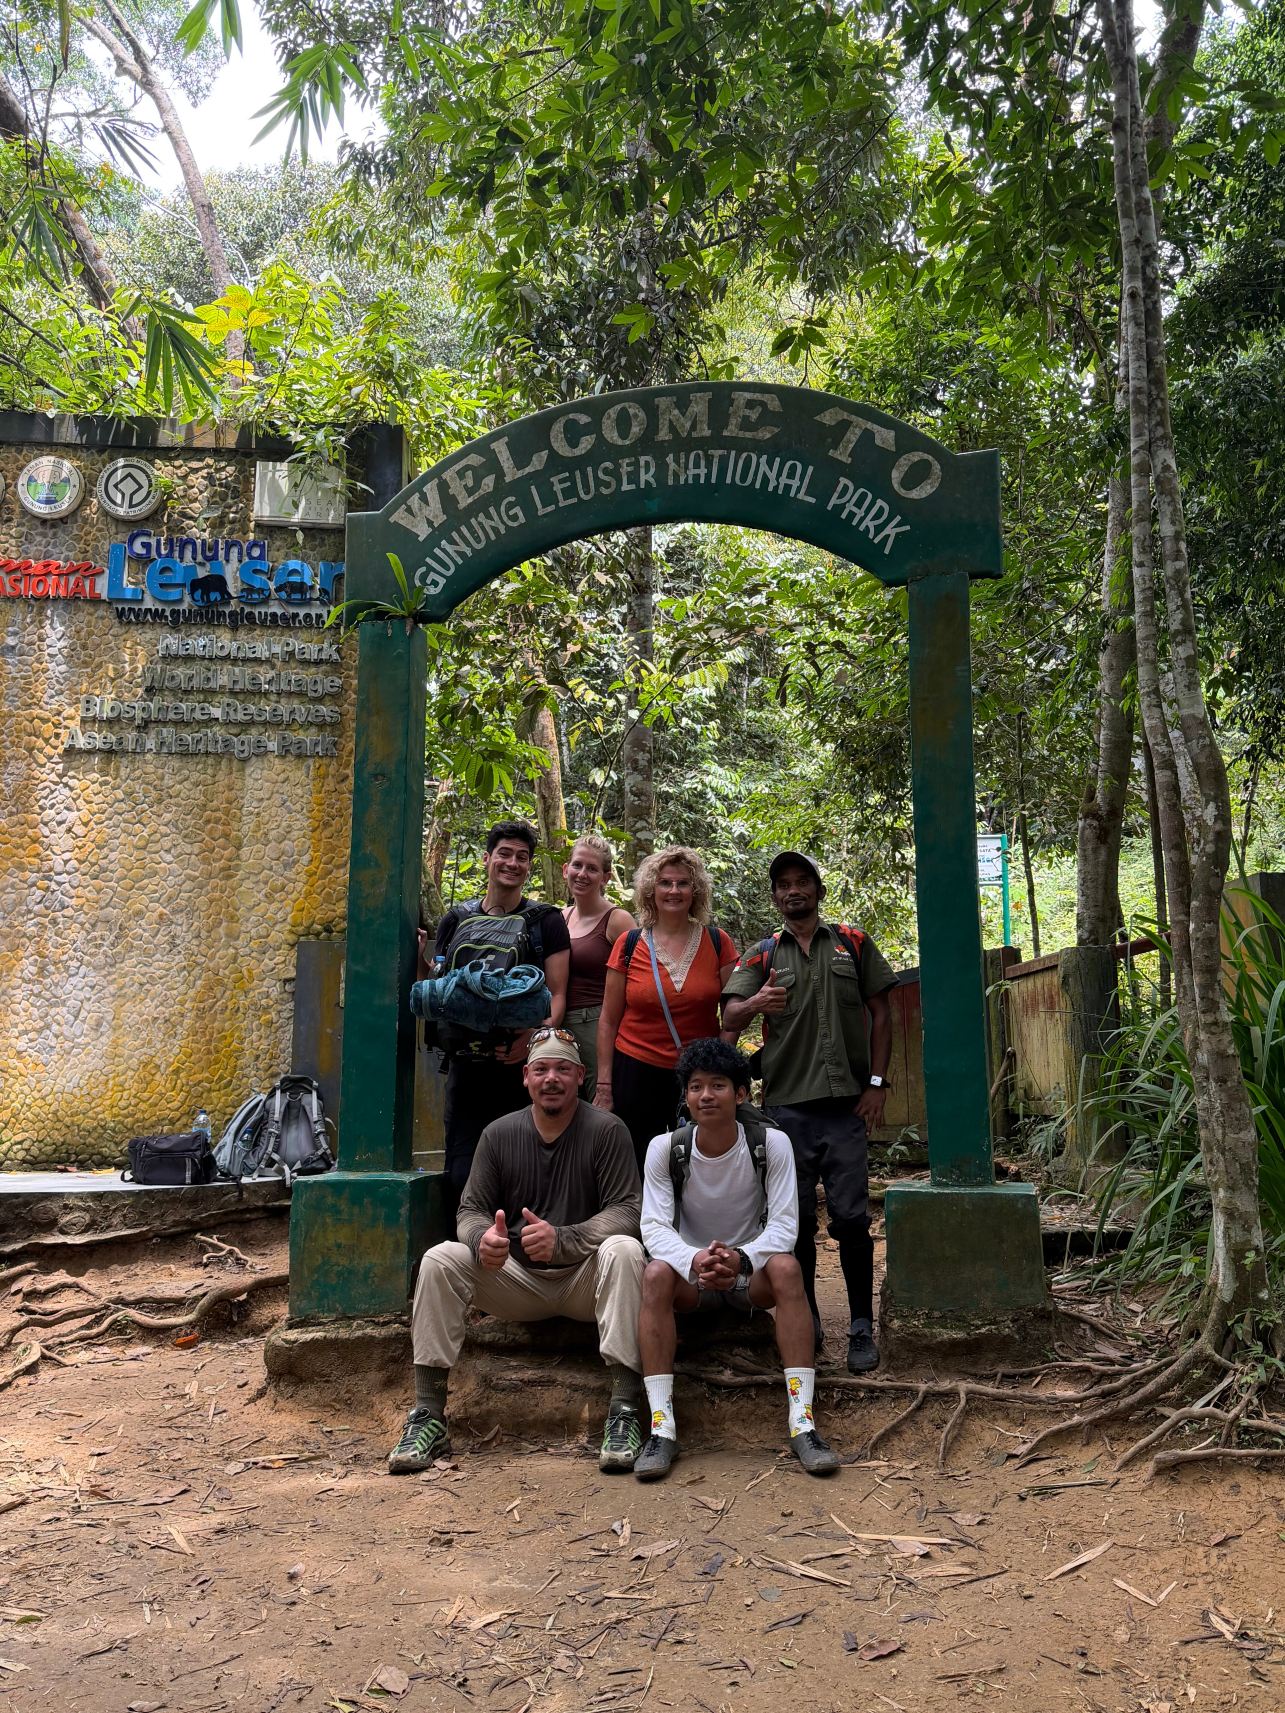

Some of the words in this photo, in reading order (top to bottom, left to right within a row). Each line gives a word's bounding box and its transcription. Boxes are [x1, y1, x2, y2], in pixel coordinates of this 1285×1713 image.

[389, 391, 784, 542] WELCOME
[813, 406, 942, 499] TO
[297, 498, 345, 507] SEAN
[414, 496, 526, 595] GUNUNG
[530, 456, 657, 516] LEUSER
[666, 450, 817, 503] NATIONAL
[827, 477, 911, 555] PARK
[0, 558, 105, 577] man
[107, 543, 345, 607] Leuser
[0, 574, 102, 599] SIONAL
[115, 606, 343, 628] www.gunungleuser.or.
[158, 633, 273, 661] National
[279, 638, 342, 663] Park
[143, 665, 220, 690] World
[226, 667, 344, 699] Heritage
[80, 696, 213, 726] Biosphere
[220, 699, 341, 725] Reserves
[63, 727, 147, 753] Asean
[153, 728, 269, 761] Heritage
[275, 731, 338, 757] Park
